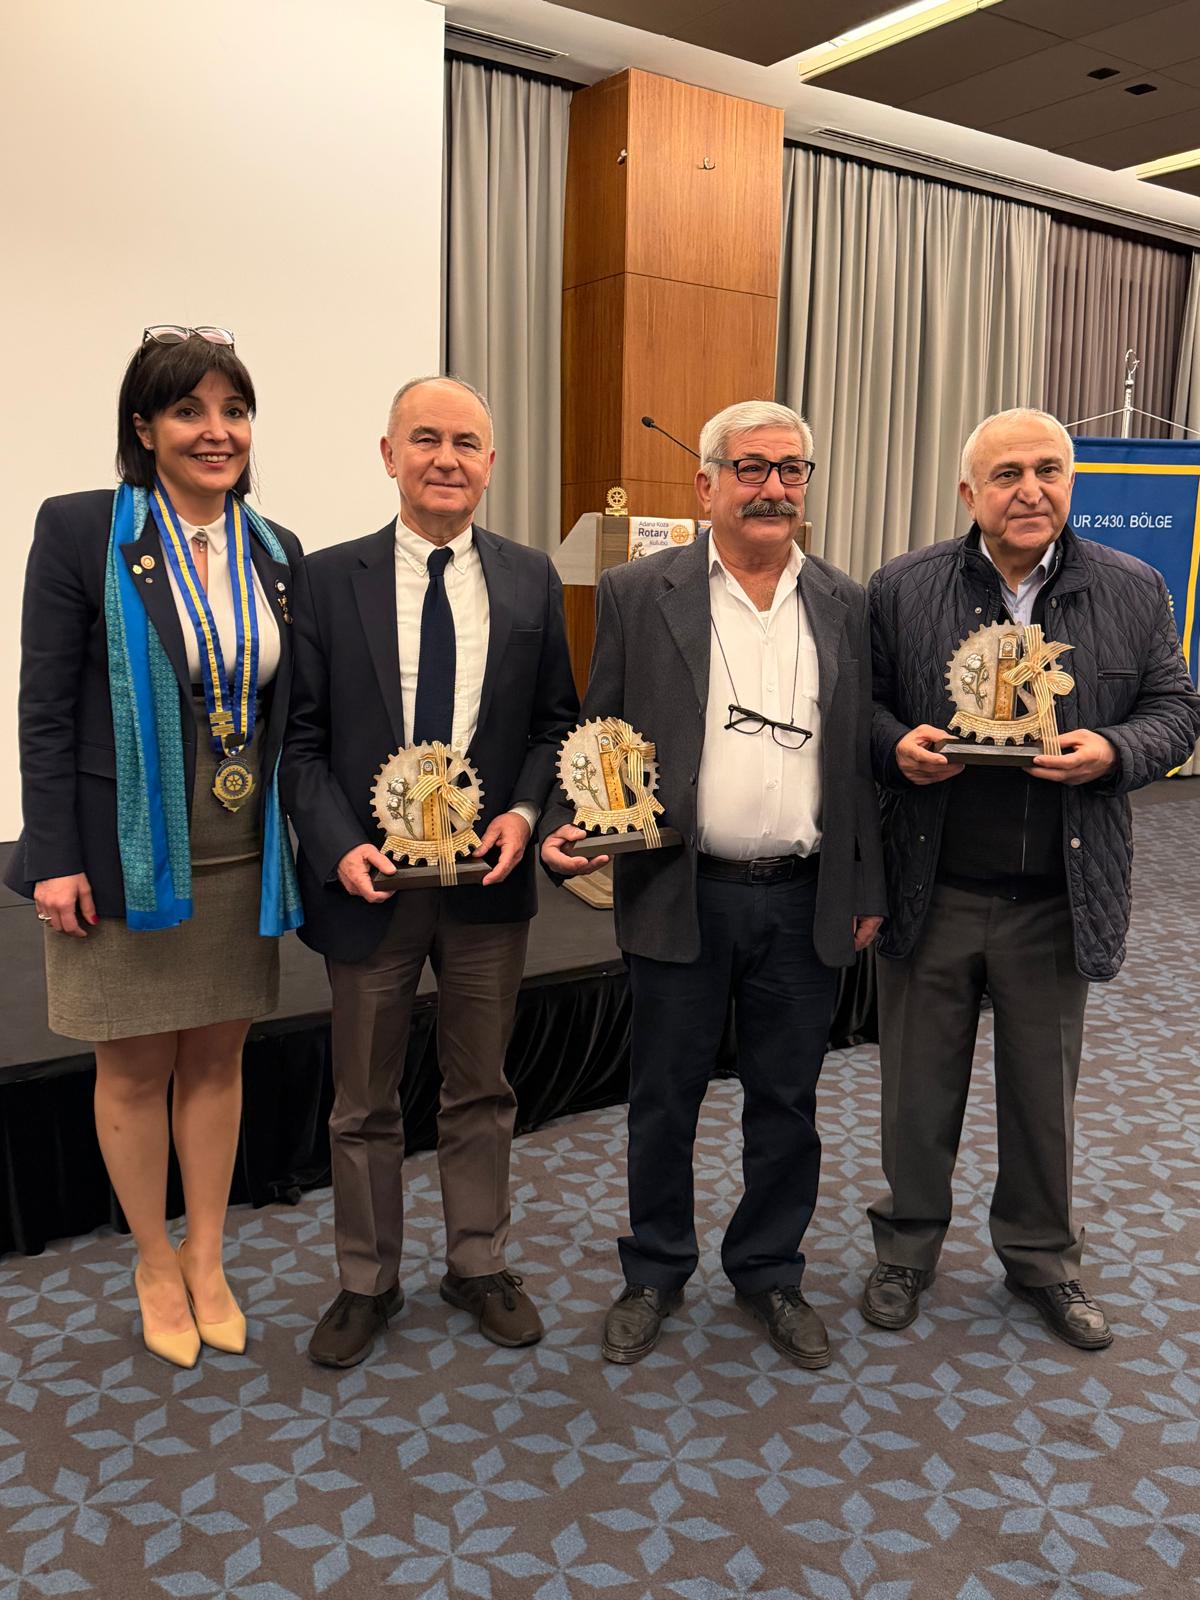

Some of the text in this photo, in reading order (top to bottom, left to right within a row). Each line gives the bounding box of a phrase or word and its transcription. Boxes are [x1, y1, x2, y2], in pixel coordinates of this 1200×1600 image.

[1073, 512, 1173, 528] UR 2430. BÖLGE
[638, 528, 668, 539] Rotary
